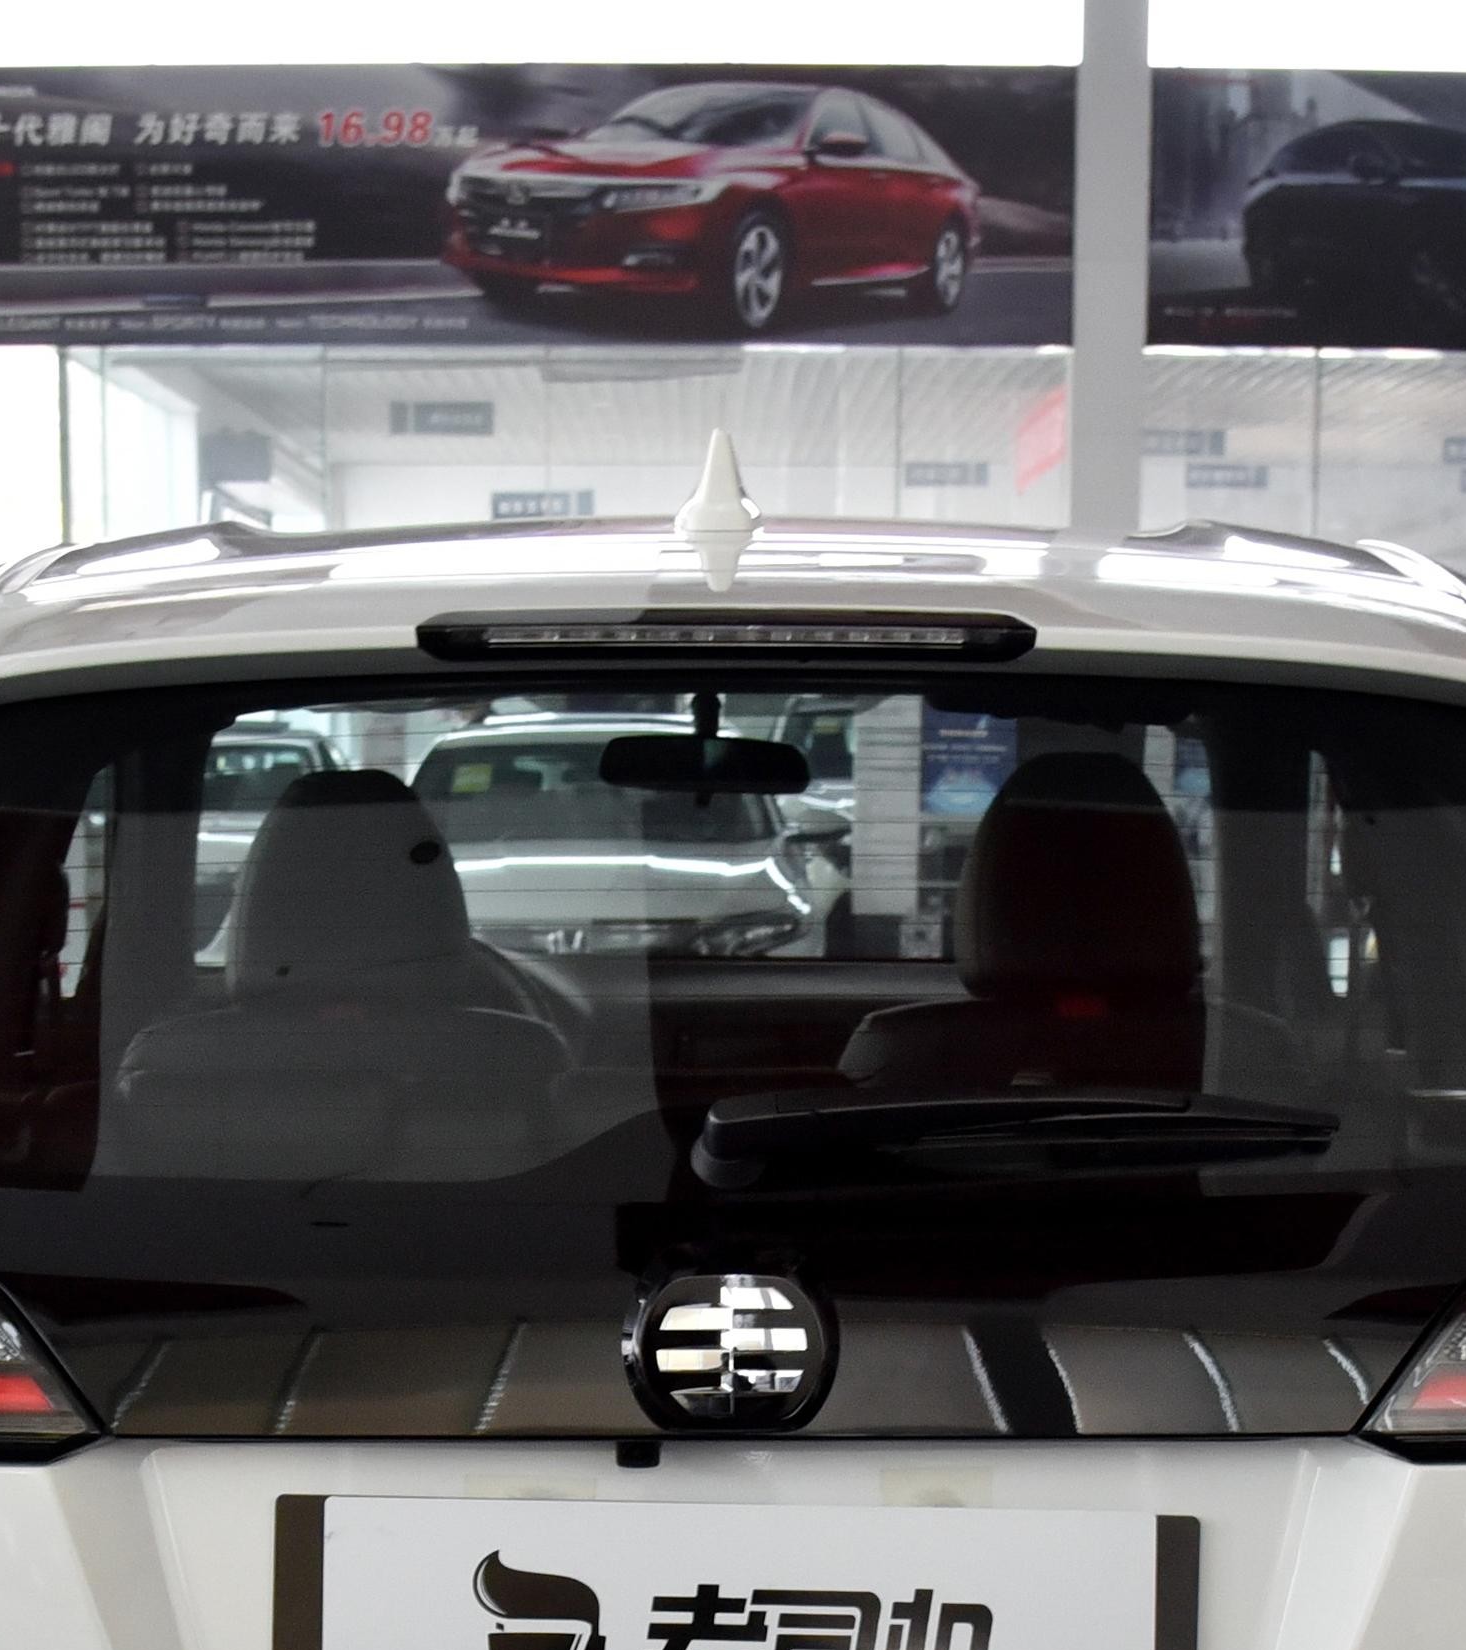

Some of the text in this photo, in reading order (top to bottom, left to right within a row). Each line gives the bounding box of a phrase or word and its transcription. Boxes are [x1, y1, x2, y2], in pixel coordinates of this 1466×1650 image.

[134, 112, 301, 147] 为好奇而来
